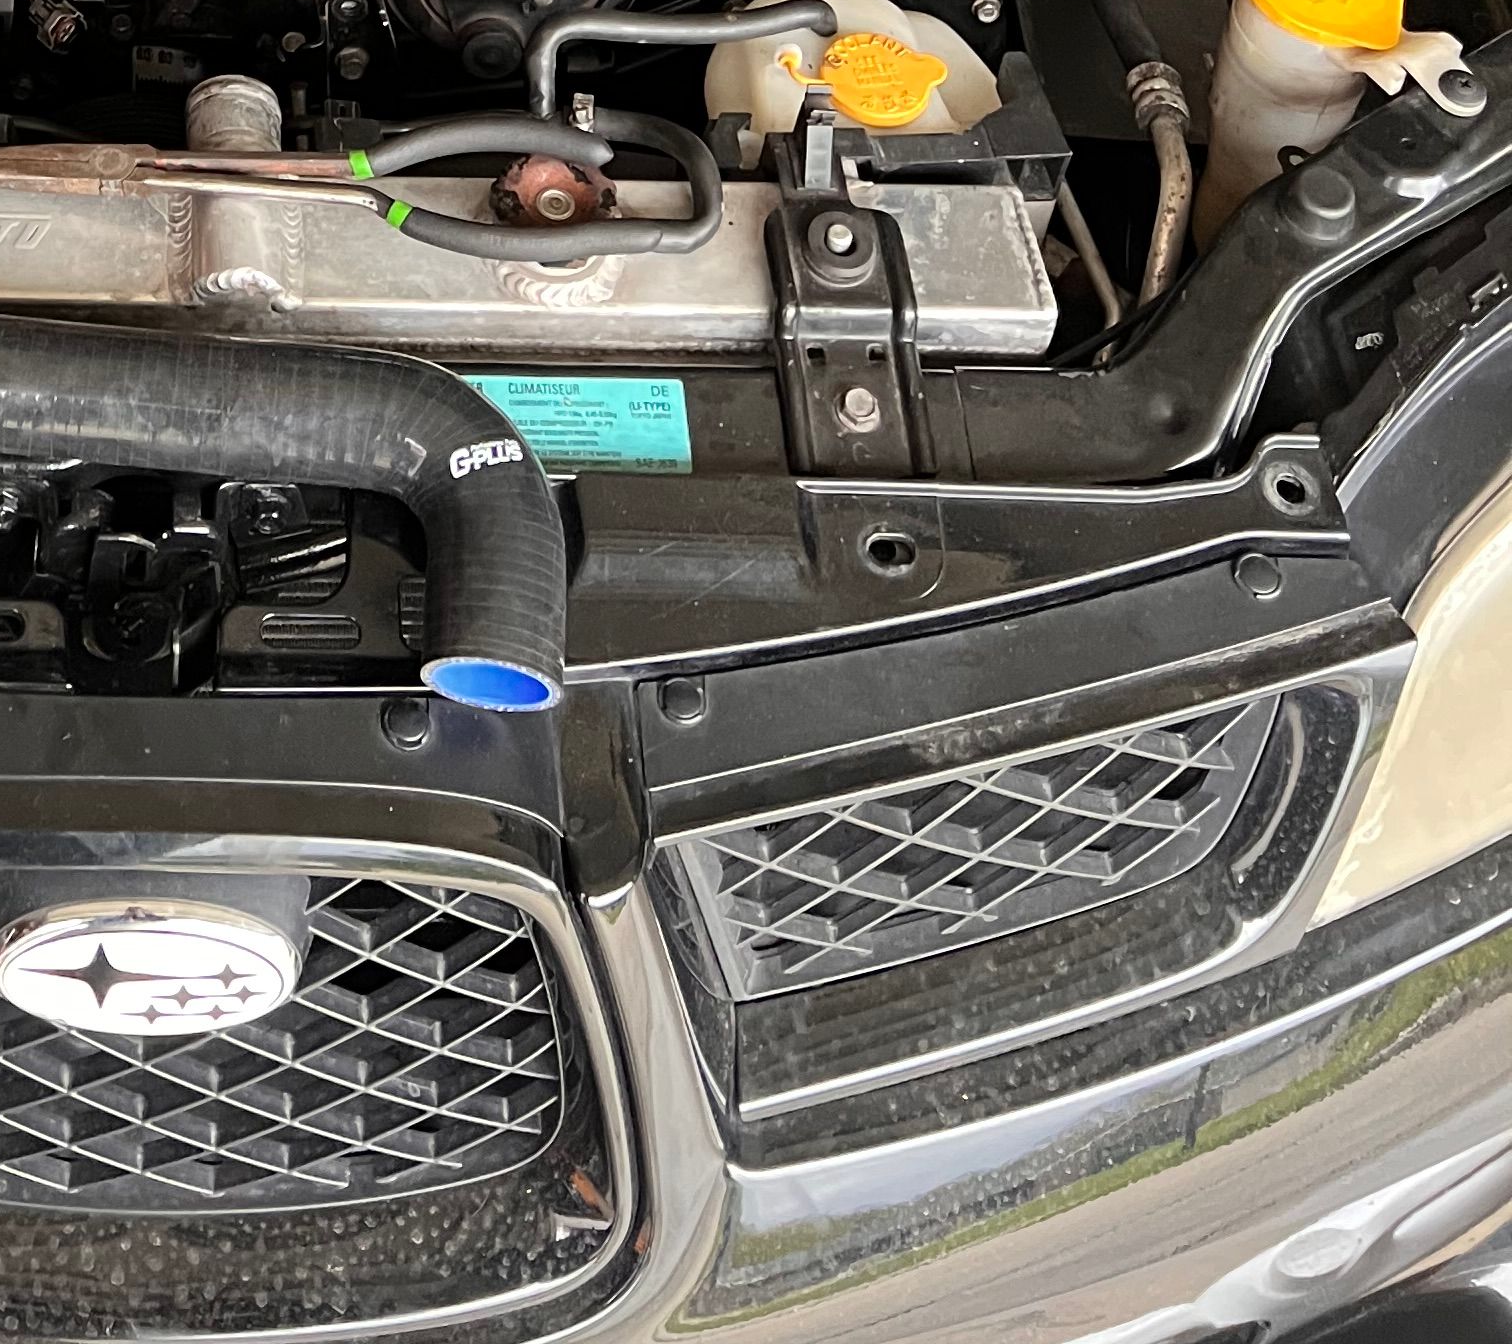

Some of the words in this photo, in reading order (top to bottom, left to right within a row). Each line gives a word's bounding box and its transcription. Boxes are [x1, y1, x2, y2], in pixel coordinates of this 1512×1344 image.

[825, 34, 912, 69] COOLANT
[508, 382, 580, 395] CLIMATISEUR
[651, 385, 669, 397] DE
